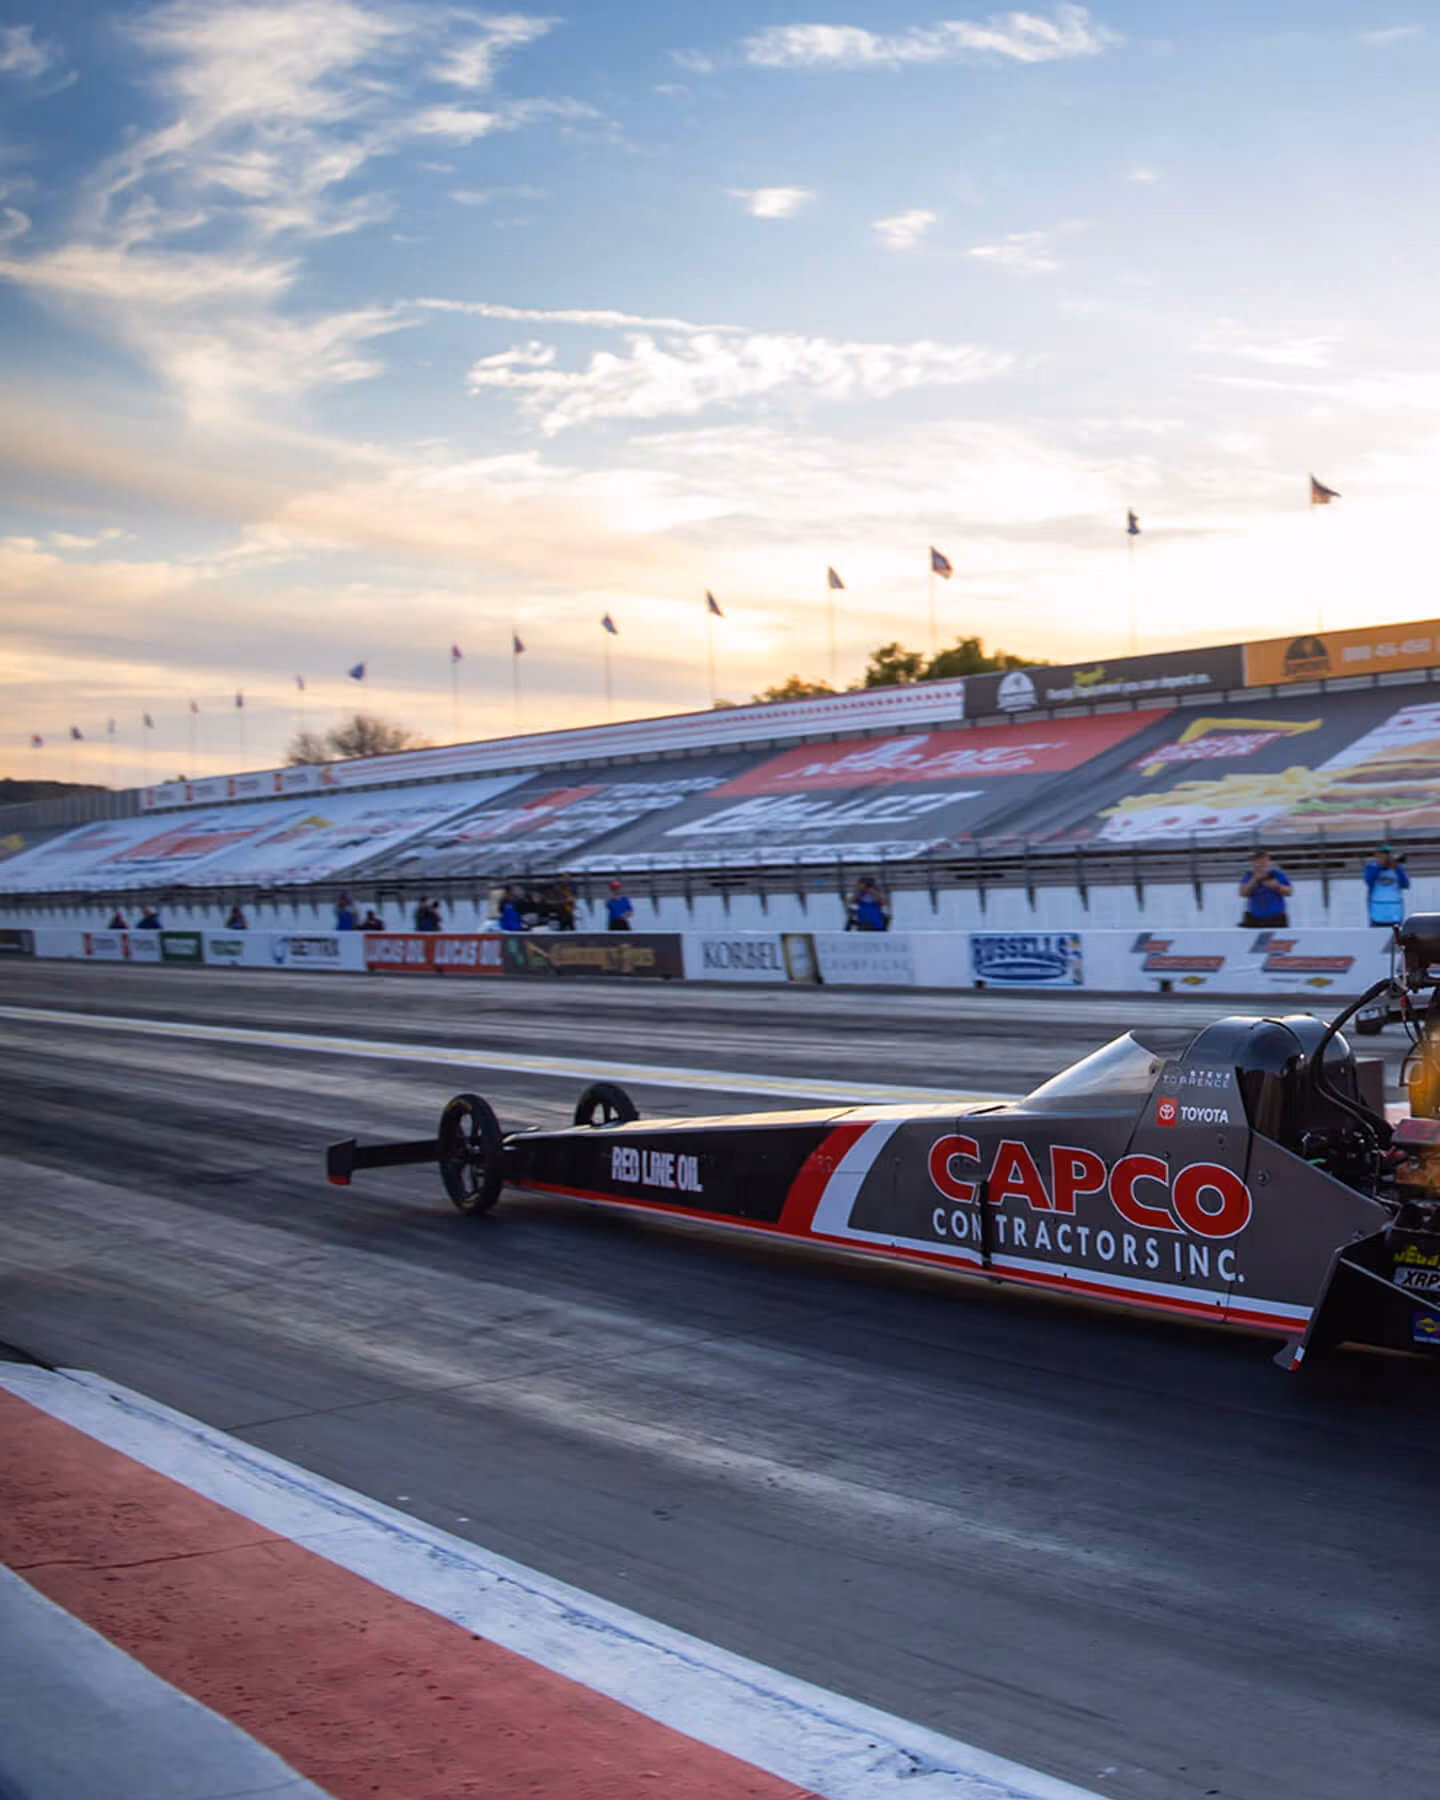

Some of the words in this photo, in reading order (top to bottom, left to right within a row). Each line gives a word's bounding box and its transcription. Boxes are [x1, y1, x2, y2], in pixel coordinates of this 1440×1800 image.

[703, 941, 783, 972] KORBEL
[1189, 1070, 1231, 1079] STEVE
[1180, 1106, 1229, 1124] TOYOTA
[611, 1145, 640, 1183] RED
[641, 1149, 677, 1189] LINE
[677, 1154, 704, 1193] OIL
[928, 1134, 1253, 1239] CAPCO
[932, 1206, 1161, 1270] CONTRACTORS
[1174, 1241, 1246, 1283] INC.
[1402, 1270, 1440, 1292] XRP
